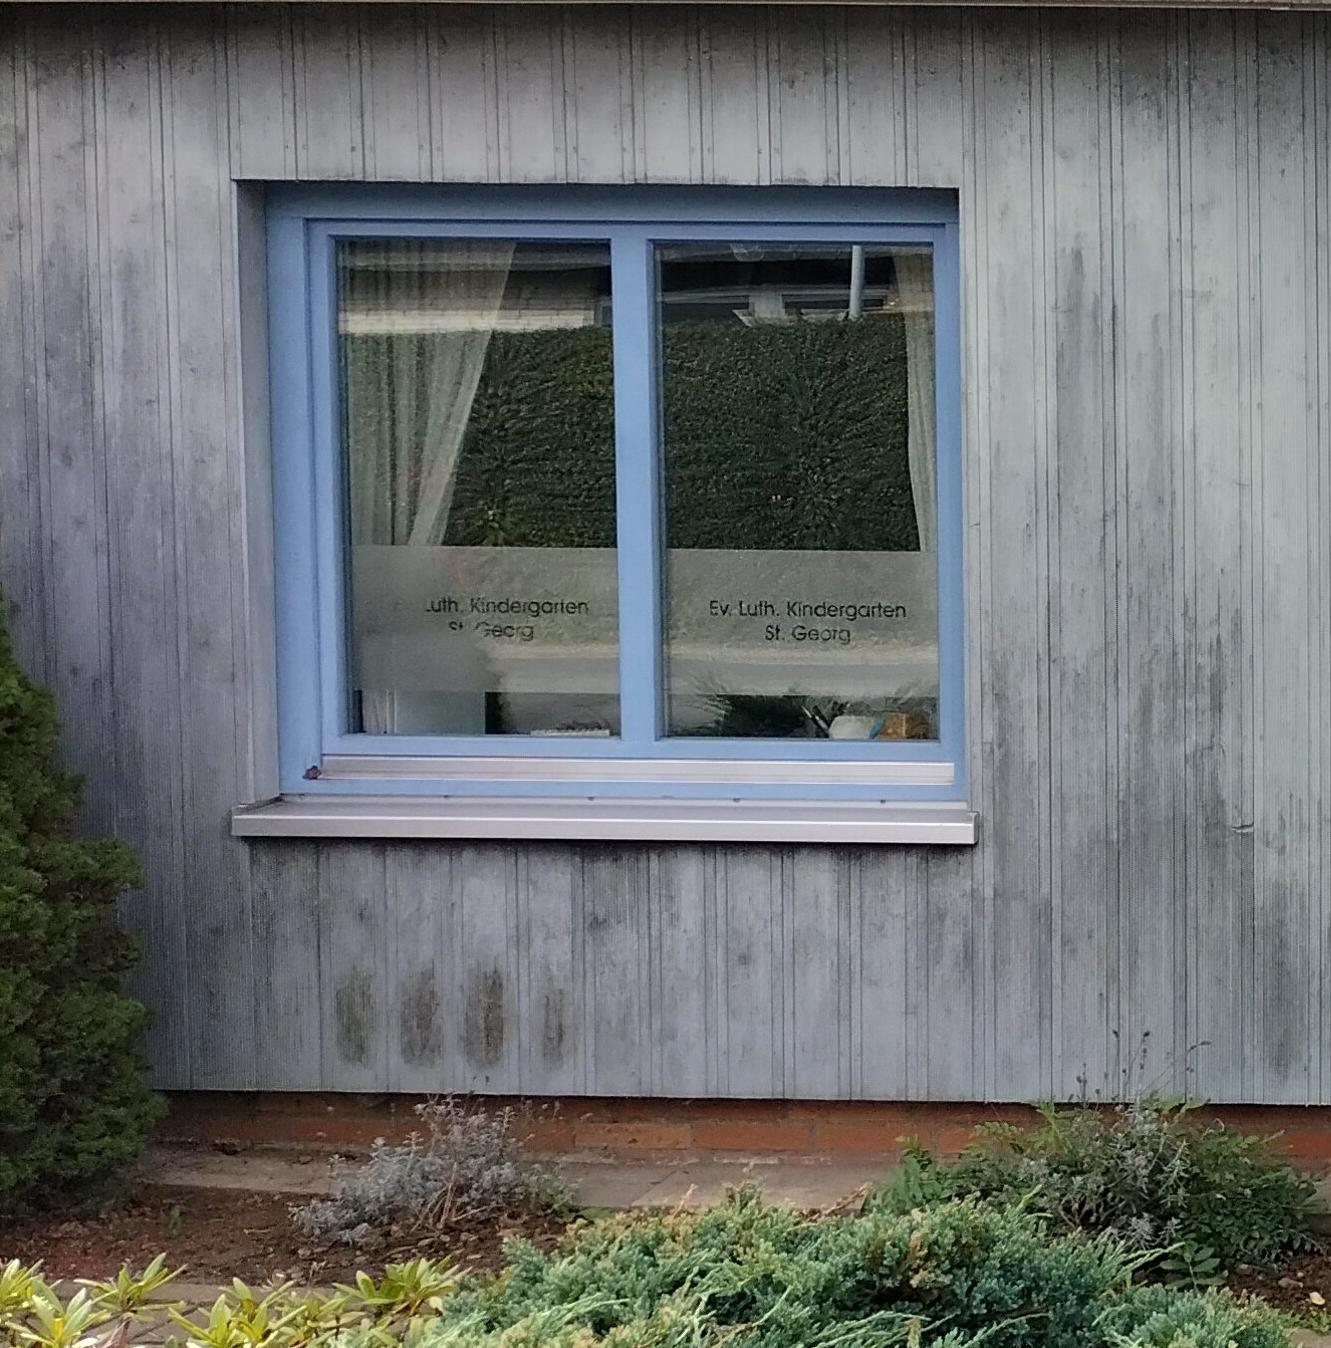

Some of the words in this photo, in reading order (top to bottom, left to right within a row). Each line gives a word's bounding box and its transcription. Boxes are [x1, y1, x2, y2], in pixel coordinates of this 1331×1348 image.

[470, 596, 589, 618] Kindergarten
[709, 600, 731, 616] Ev.
[739, 600, 780, 616] Luth.
[787, 600, 907, 622] Kindergarten
[765, 624, 785, 641] St.
[792, 624, 851, 644] Georg
